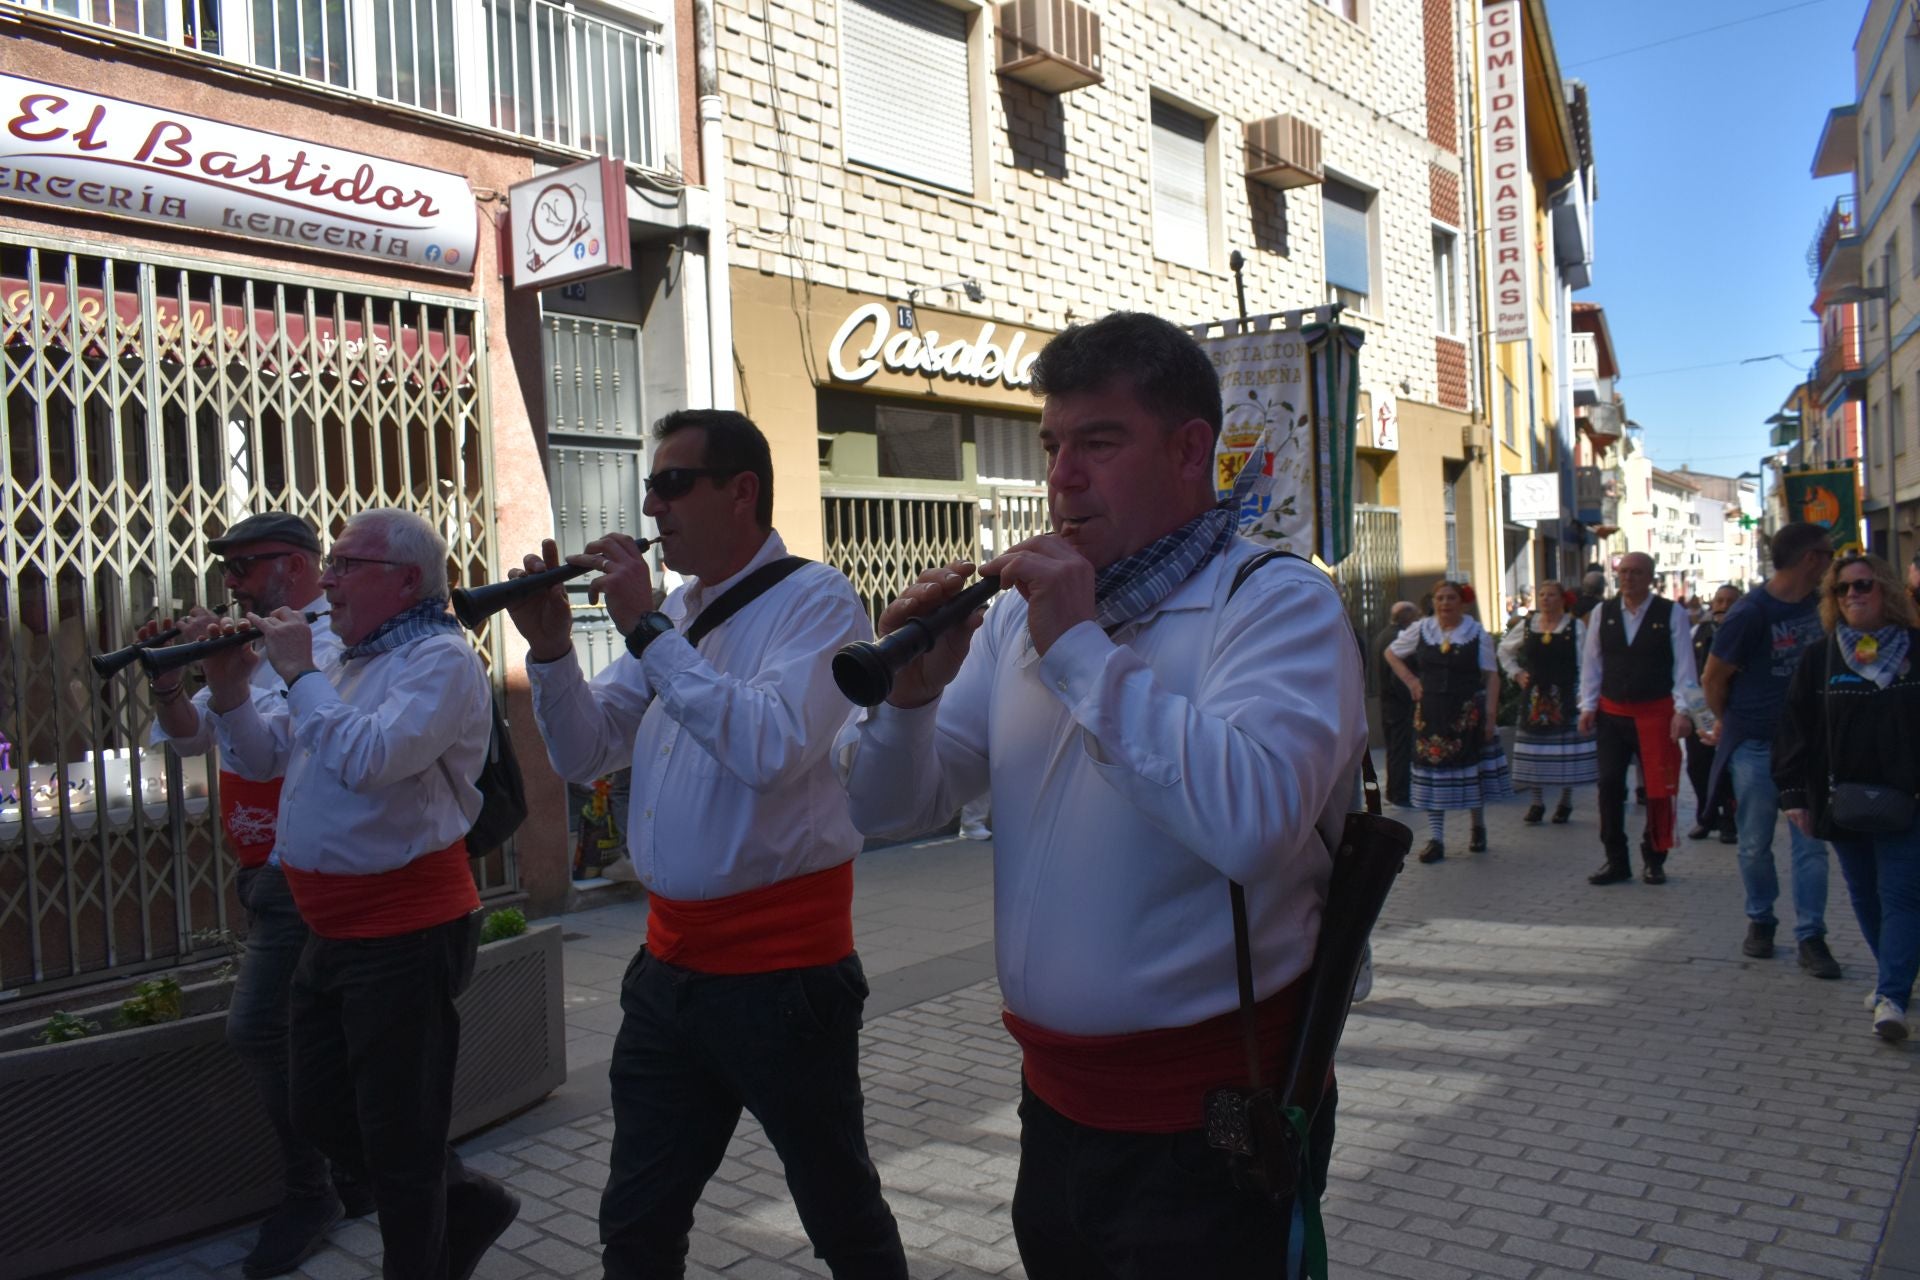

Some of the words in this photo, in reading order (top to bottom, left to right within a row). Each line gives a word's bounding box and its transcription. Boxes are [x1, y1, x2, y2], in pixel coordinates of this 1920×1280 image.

[1487, 9, 1515, 153] COMIDAS
[7, 93, 108, 152] El
[133, 120, 440, 218] Bastidor
[221, 207, 411, 258] LENCERÍA
[1495, 162, 1521, 305] CASERAS
[899, 308, 914, 328] 15
